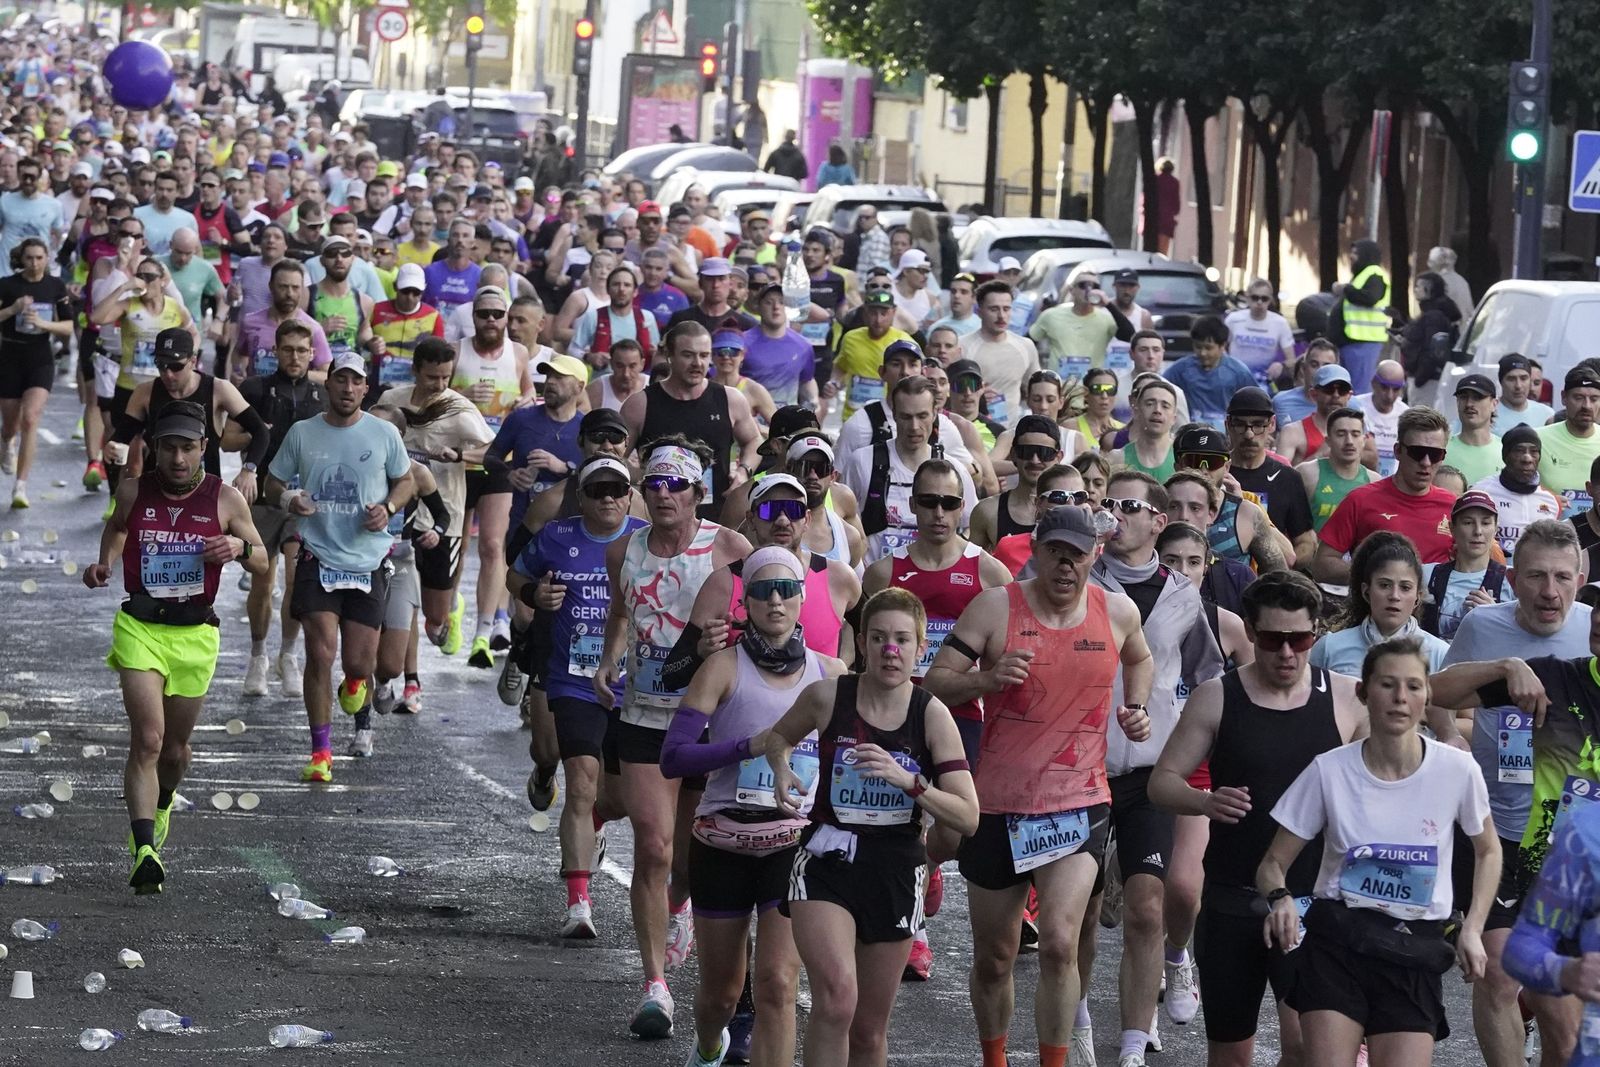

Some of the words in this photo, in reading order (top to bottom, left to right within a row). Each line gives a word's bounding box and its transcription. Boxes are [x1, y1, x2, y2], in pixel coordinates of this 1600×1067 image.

[382, 19, 403, 32] 30
[316, 502, 359, 514] SEVILLA
[557, 525, 574, 534] RUN
[161, 544, 196, 553] ZURICH
[162, 561, 182, 570] 6717
[143, 572, 170, 585] LUIS
[173, 569, 203, 583] JOSÉ
[1500, 755, 1532, 768] KARA
[838, 788, 905, 807] CLÀUDIA
[1021, 830, 1082, 856] JUANMA
[1378, 849, 1429, 861] ZURICH
[1360, 877, 1412, 900] ANAIS
